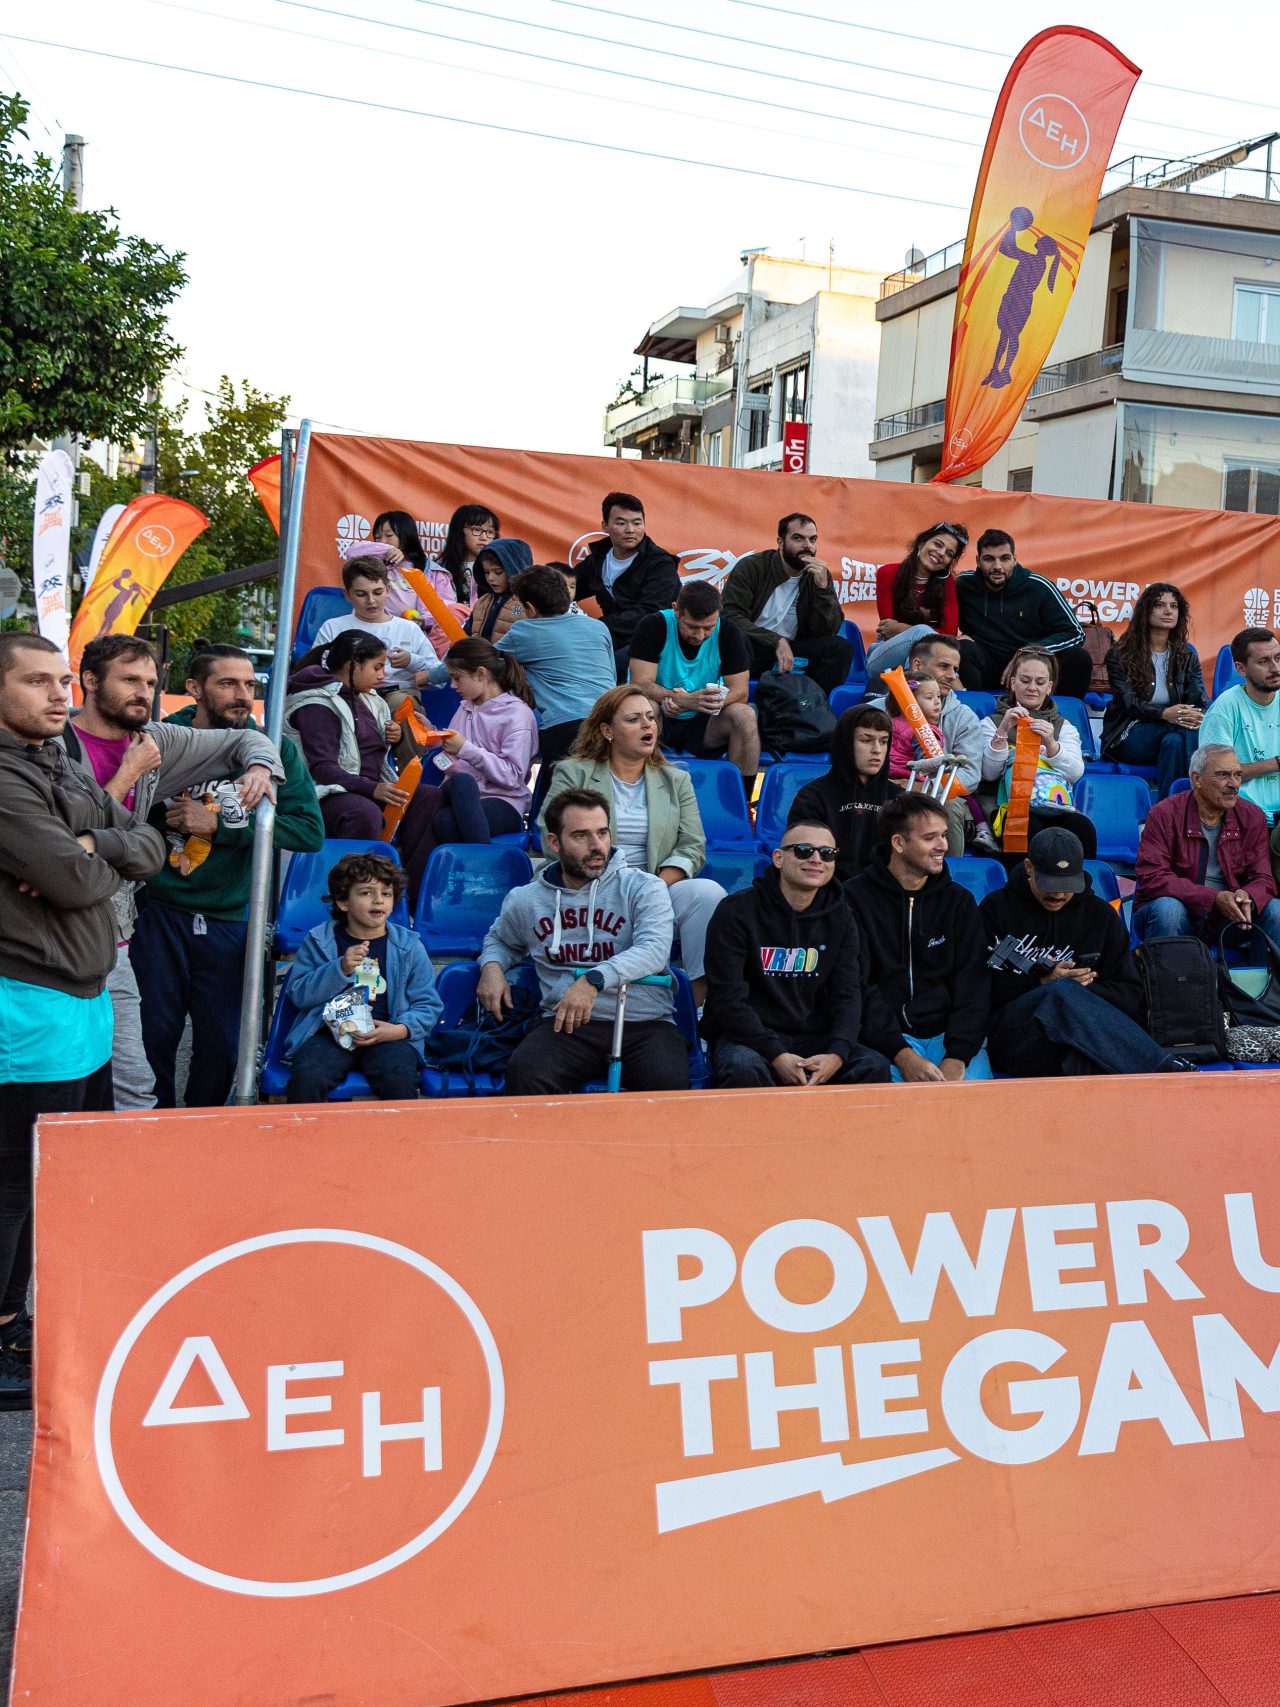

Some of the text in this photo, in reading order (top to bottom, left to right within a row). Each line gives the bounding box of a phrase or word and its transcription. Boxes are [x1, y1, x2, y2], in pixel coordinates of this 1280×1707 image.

[1028, 107, 1078, 156] ΔΕΗ
[1057, 577, 1140, 601] POWER
[1097, 600, 1136, 622] GA
[642, 1199, 1205, 1344] POWER
[143, 1336, 443, 1478] ΔΕΗ
[649, 1338, 929, 1457] THE
